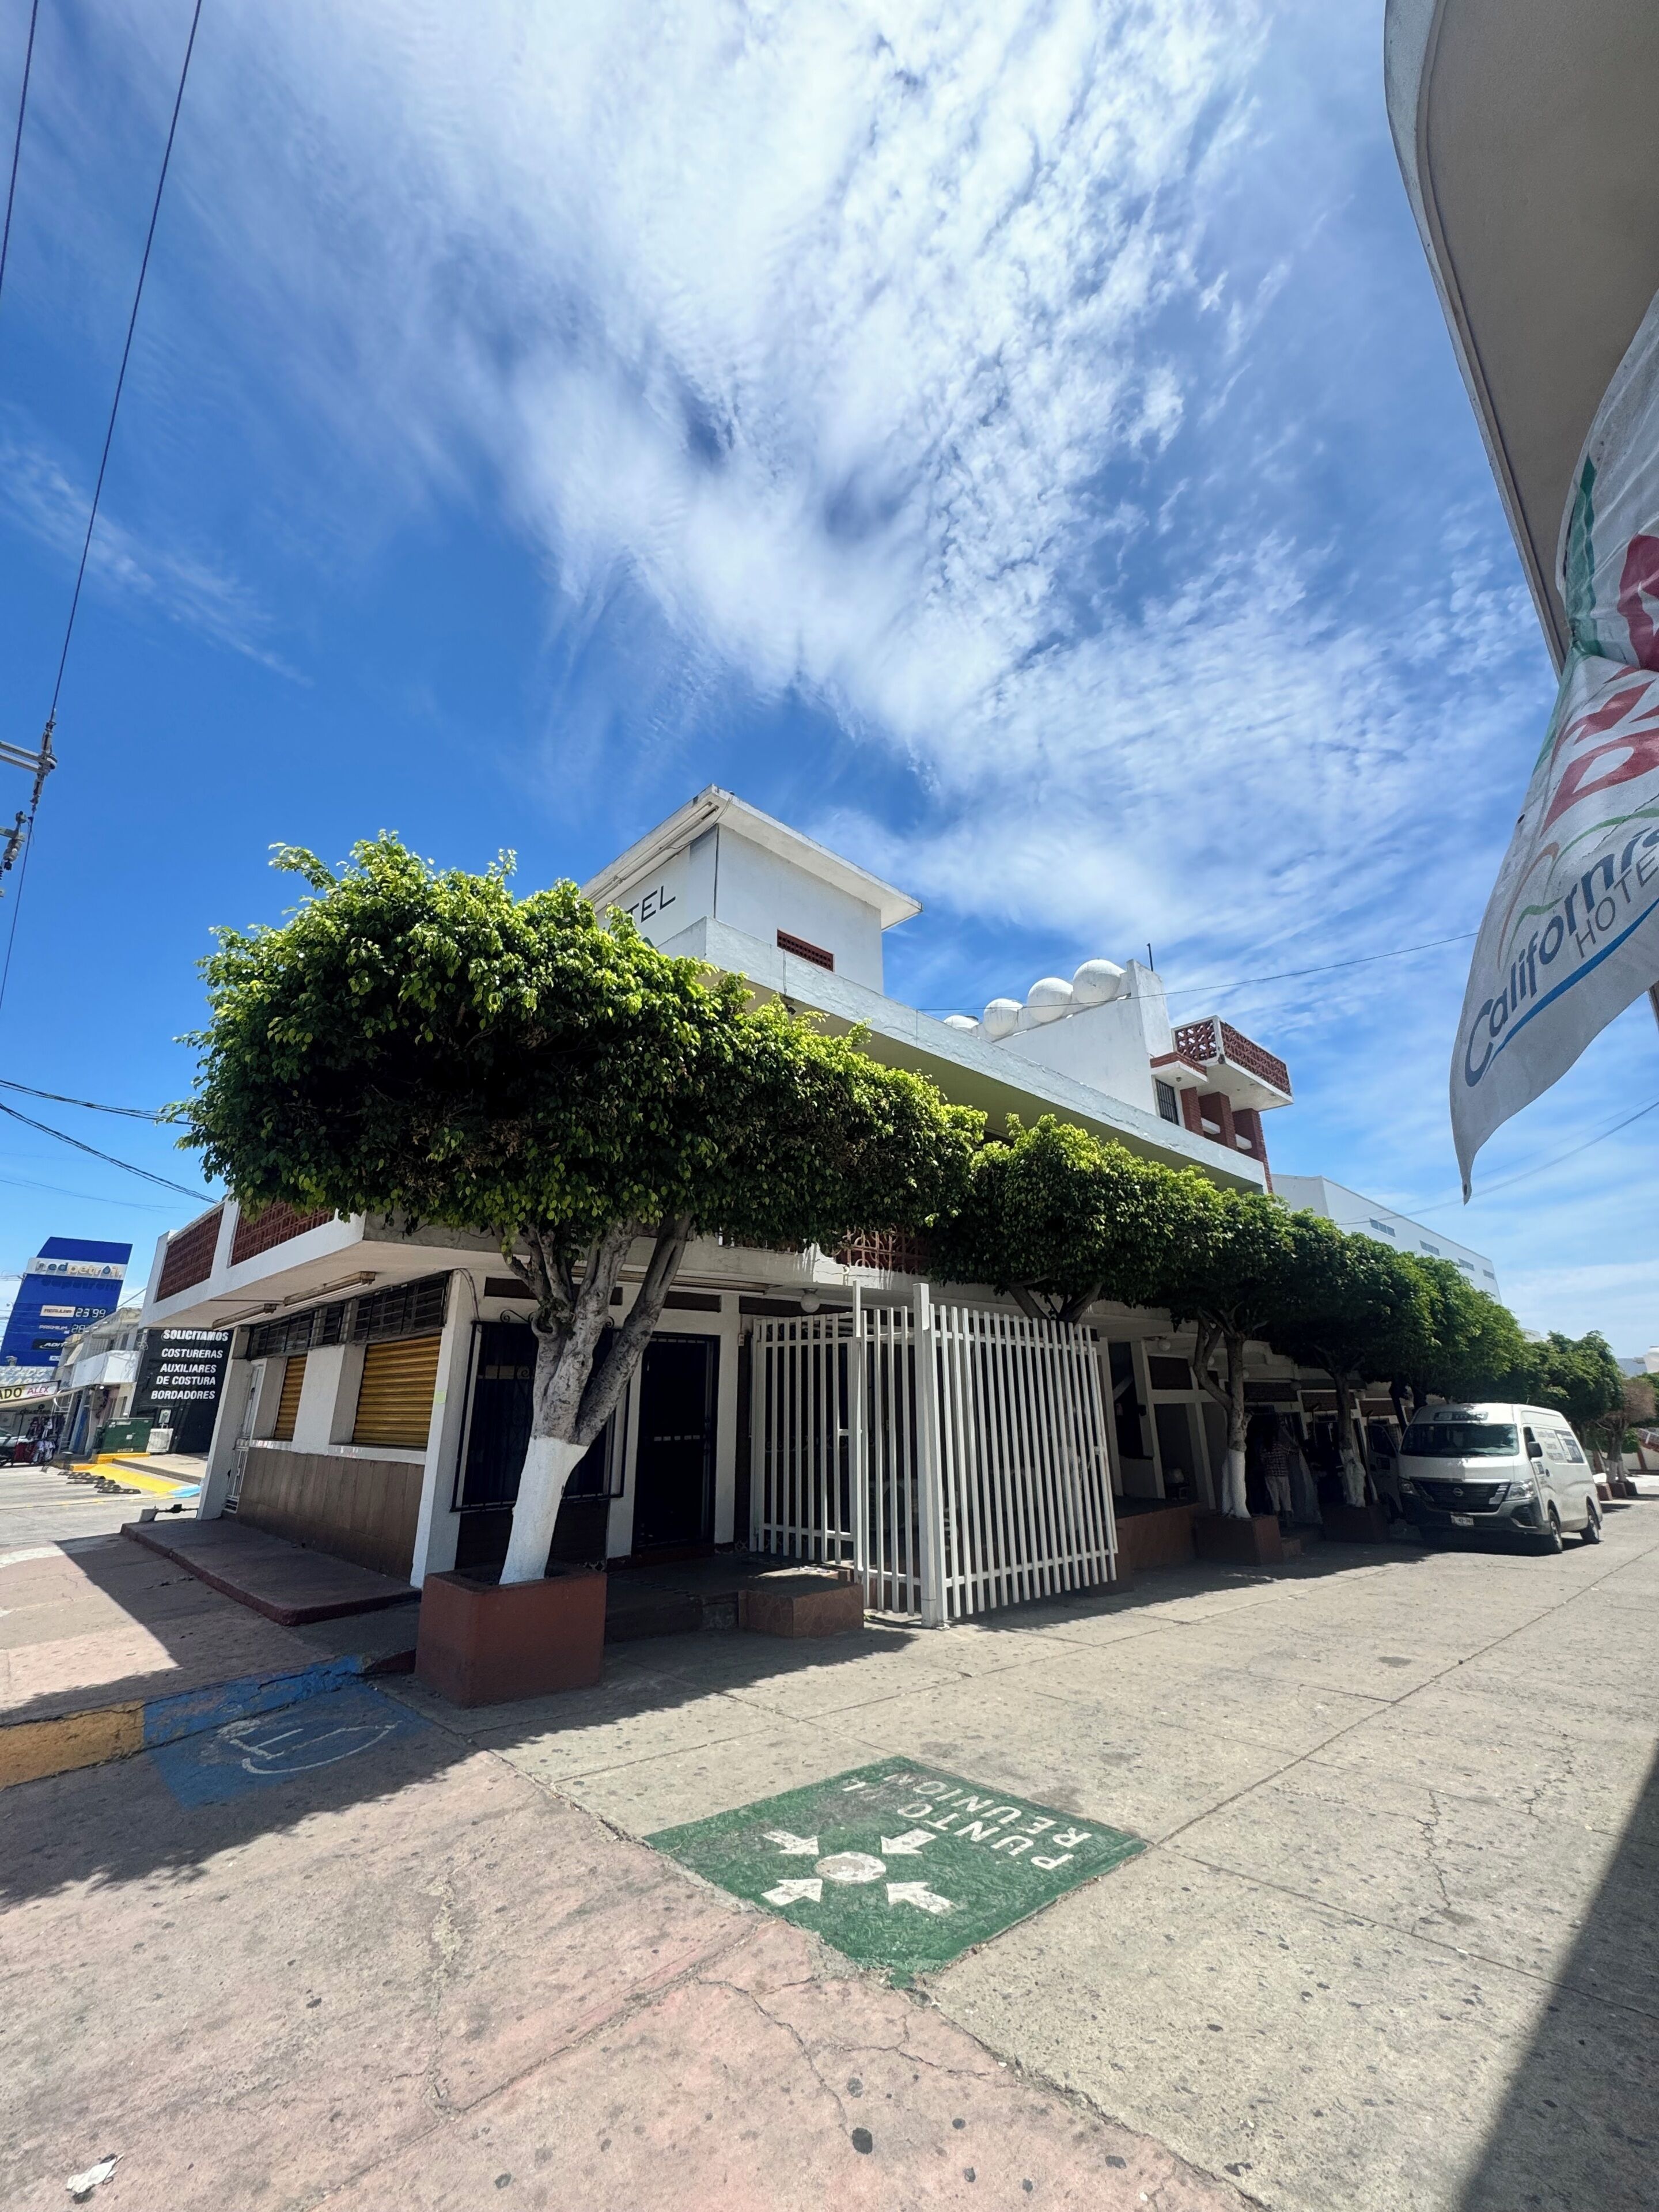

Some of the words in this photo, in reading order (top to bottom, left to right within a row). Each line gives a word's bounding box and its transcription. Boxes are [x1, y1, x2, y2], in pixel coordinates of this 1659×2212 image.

[163, 1330, 229, 1342] SOLICITAMOS
[161, 1348, 224, 1359] COSTURERAS
[160, 1363, 217, 1373] AUXILIARES
[156, 1376, 170, 1385] DE
[172, 1376, 216, 1385] COSTURA
[151, 1390, 215, 1400] BORDADORES
[896, 1802, 1074, 1870] PUNTO
